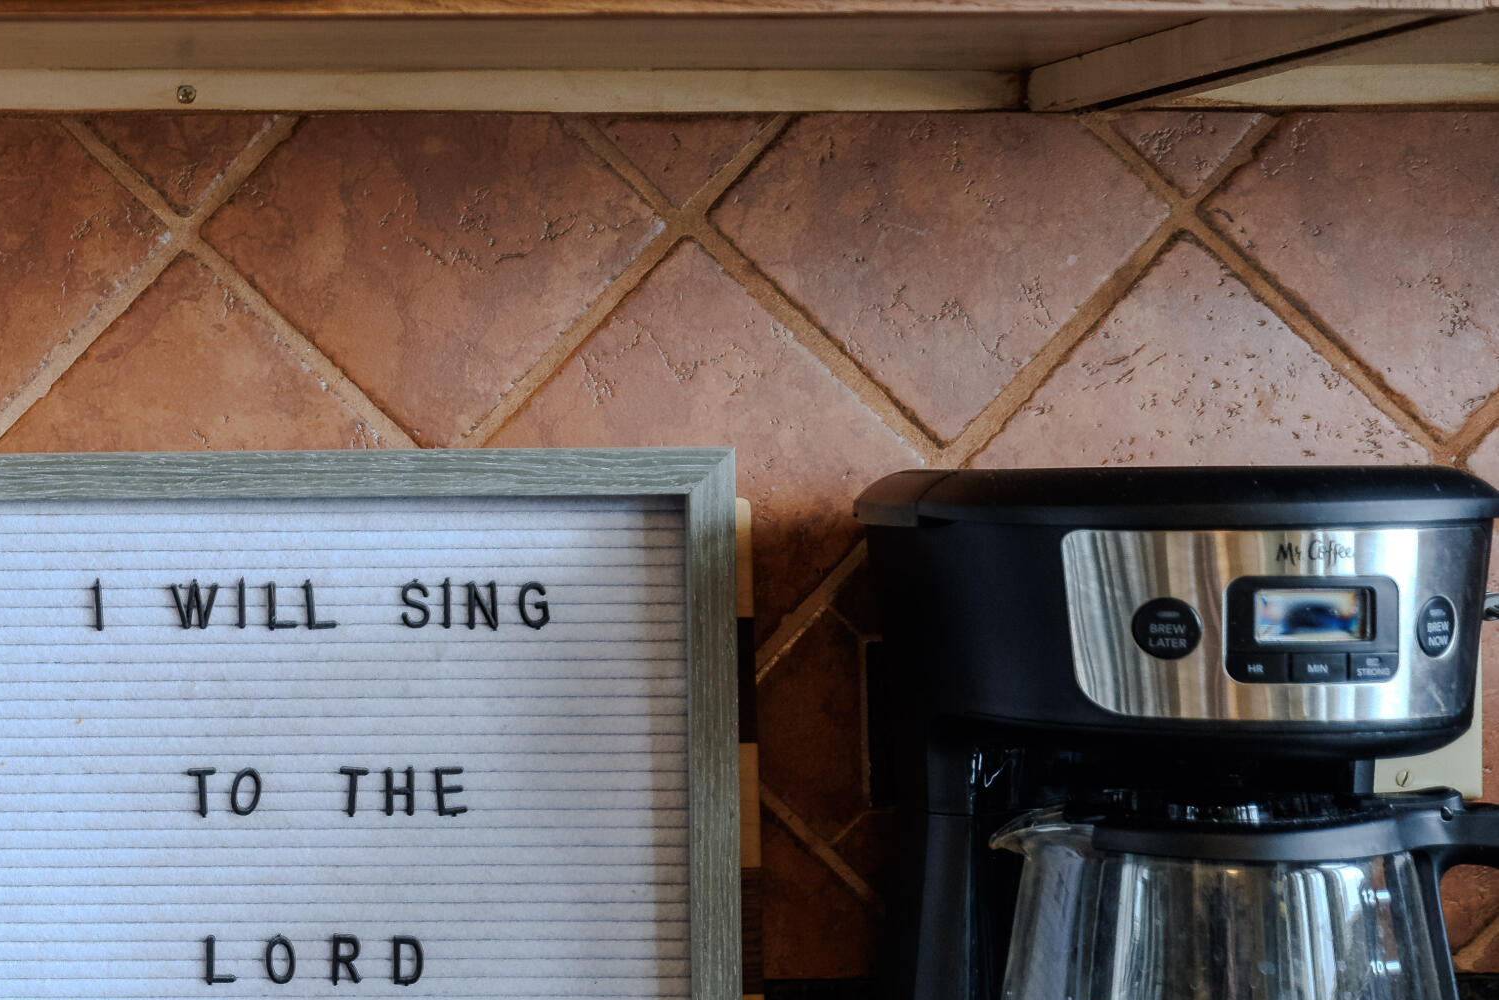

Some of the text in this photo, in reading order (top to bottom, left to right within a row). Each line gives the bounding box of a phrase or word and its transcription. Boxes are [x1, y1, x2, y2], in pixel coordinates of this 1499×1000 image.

[1308, 539, 1354, 569] Coffee
[90, 578, 551, 632] I WILL SING
[1149, 623, 1187, 635] BREW
[1427, 621, 1450, 633] BREW
[1148, 637, 1188, 648] LATER
[1428, 636, 1449, 647] NOW
[1248, 664, 1264, 673] HR
[1307, 664, 1329, 674] MIN
[1356, 667, 1391, 676] STRONG
[184, 766, 469, 819] TO THE
[1362, 888, 1376, 905] 12
[203, 934, 425, 987] LORD
[1370, 960, 1385, 976] 10
